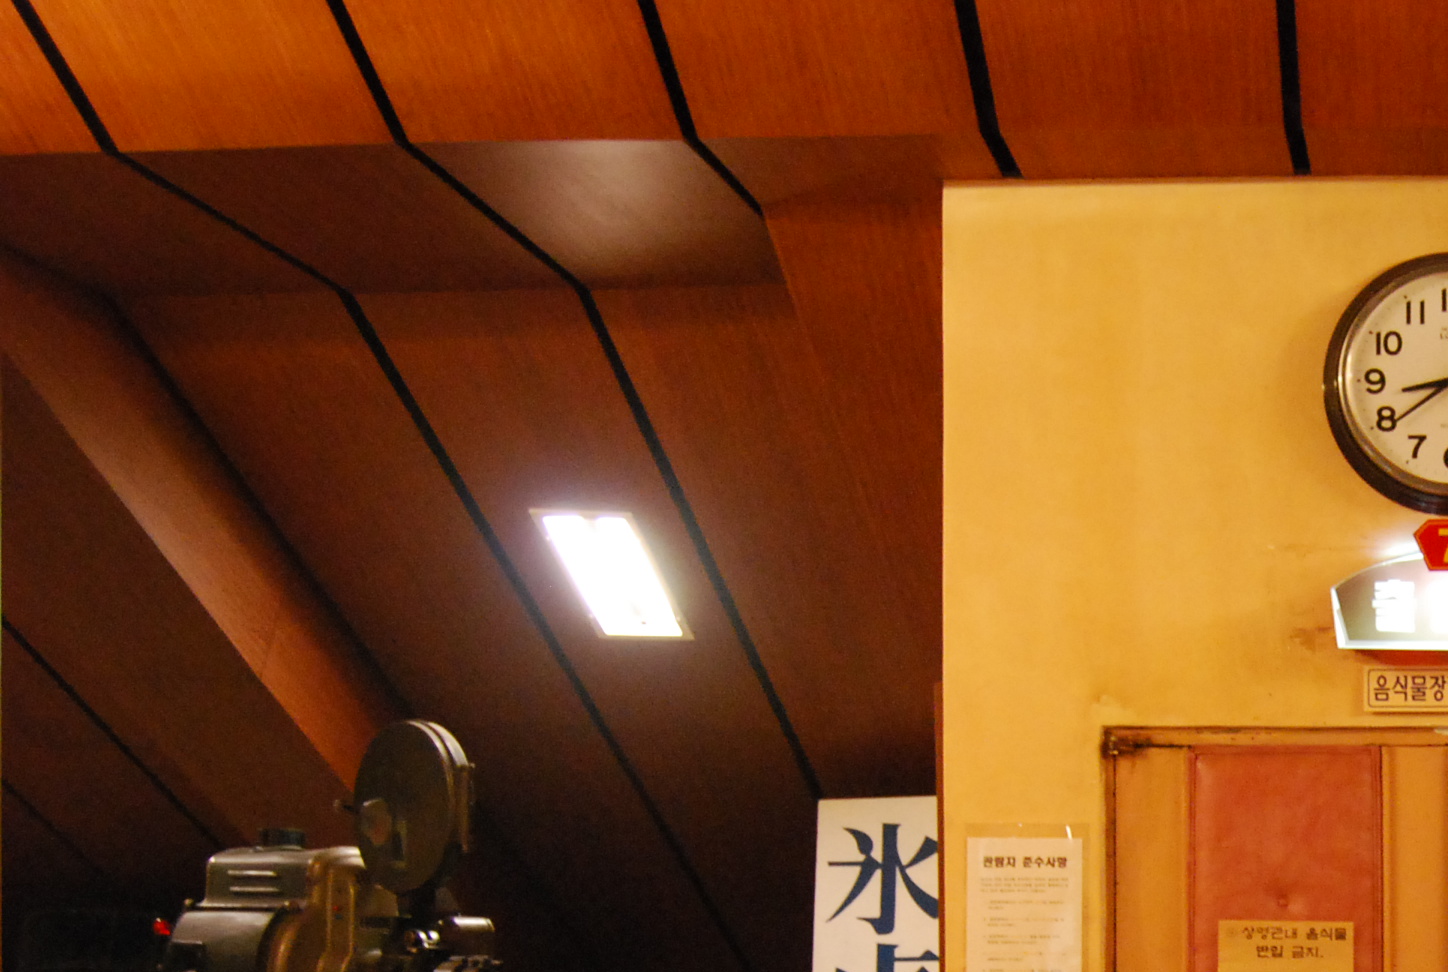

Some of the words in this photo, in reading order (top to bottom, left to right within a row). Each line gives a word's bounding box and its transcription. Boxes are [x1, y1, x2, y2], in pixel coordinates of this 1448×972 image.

[1406, 300, 1425, 325] 11
[1375, 331, 1403, 355] 10
[1364, 368, 1386, 394] 9
[1376, 406, 1397, 432] 8
[1408, 435, 1427, 459] 7
[1256, 945, 1284, 958] 반입
